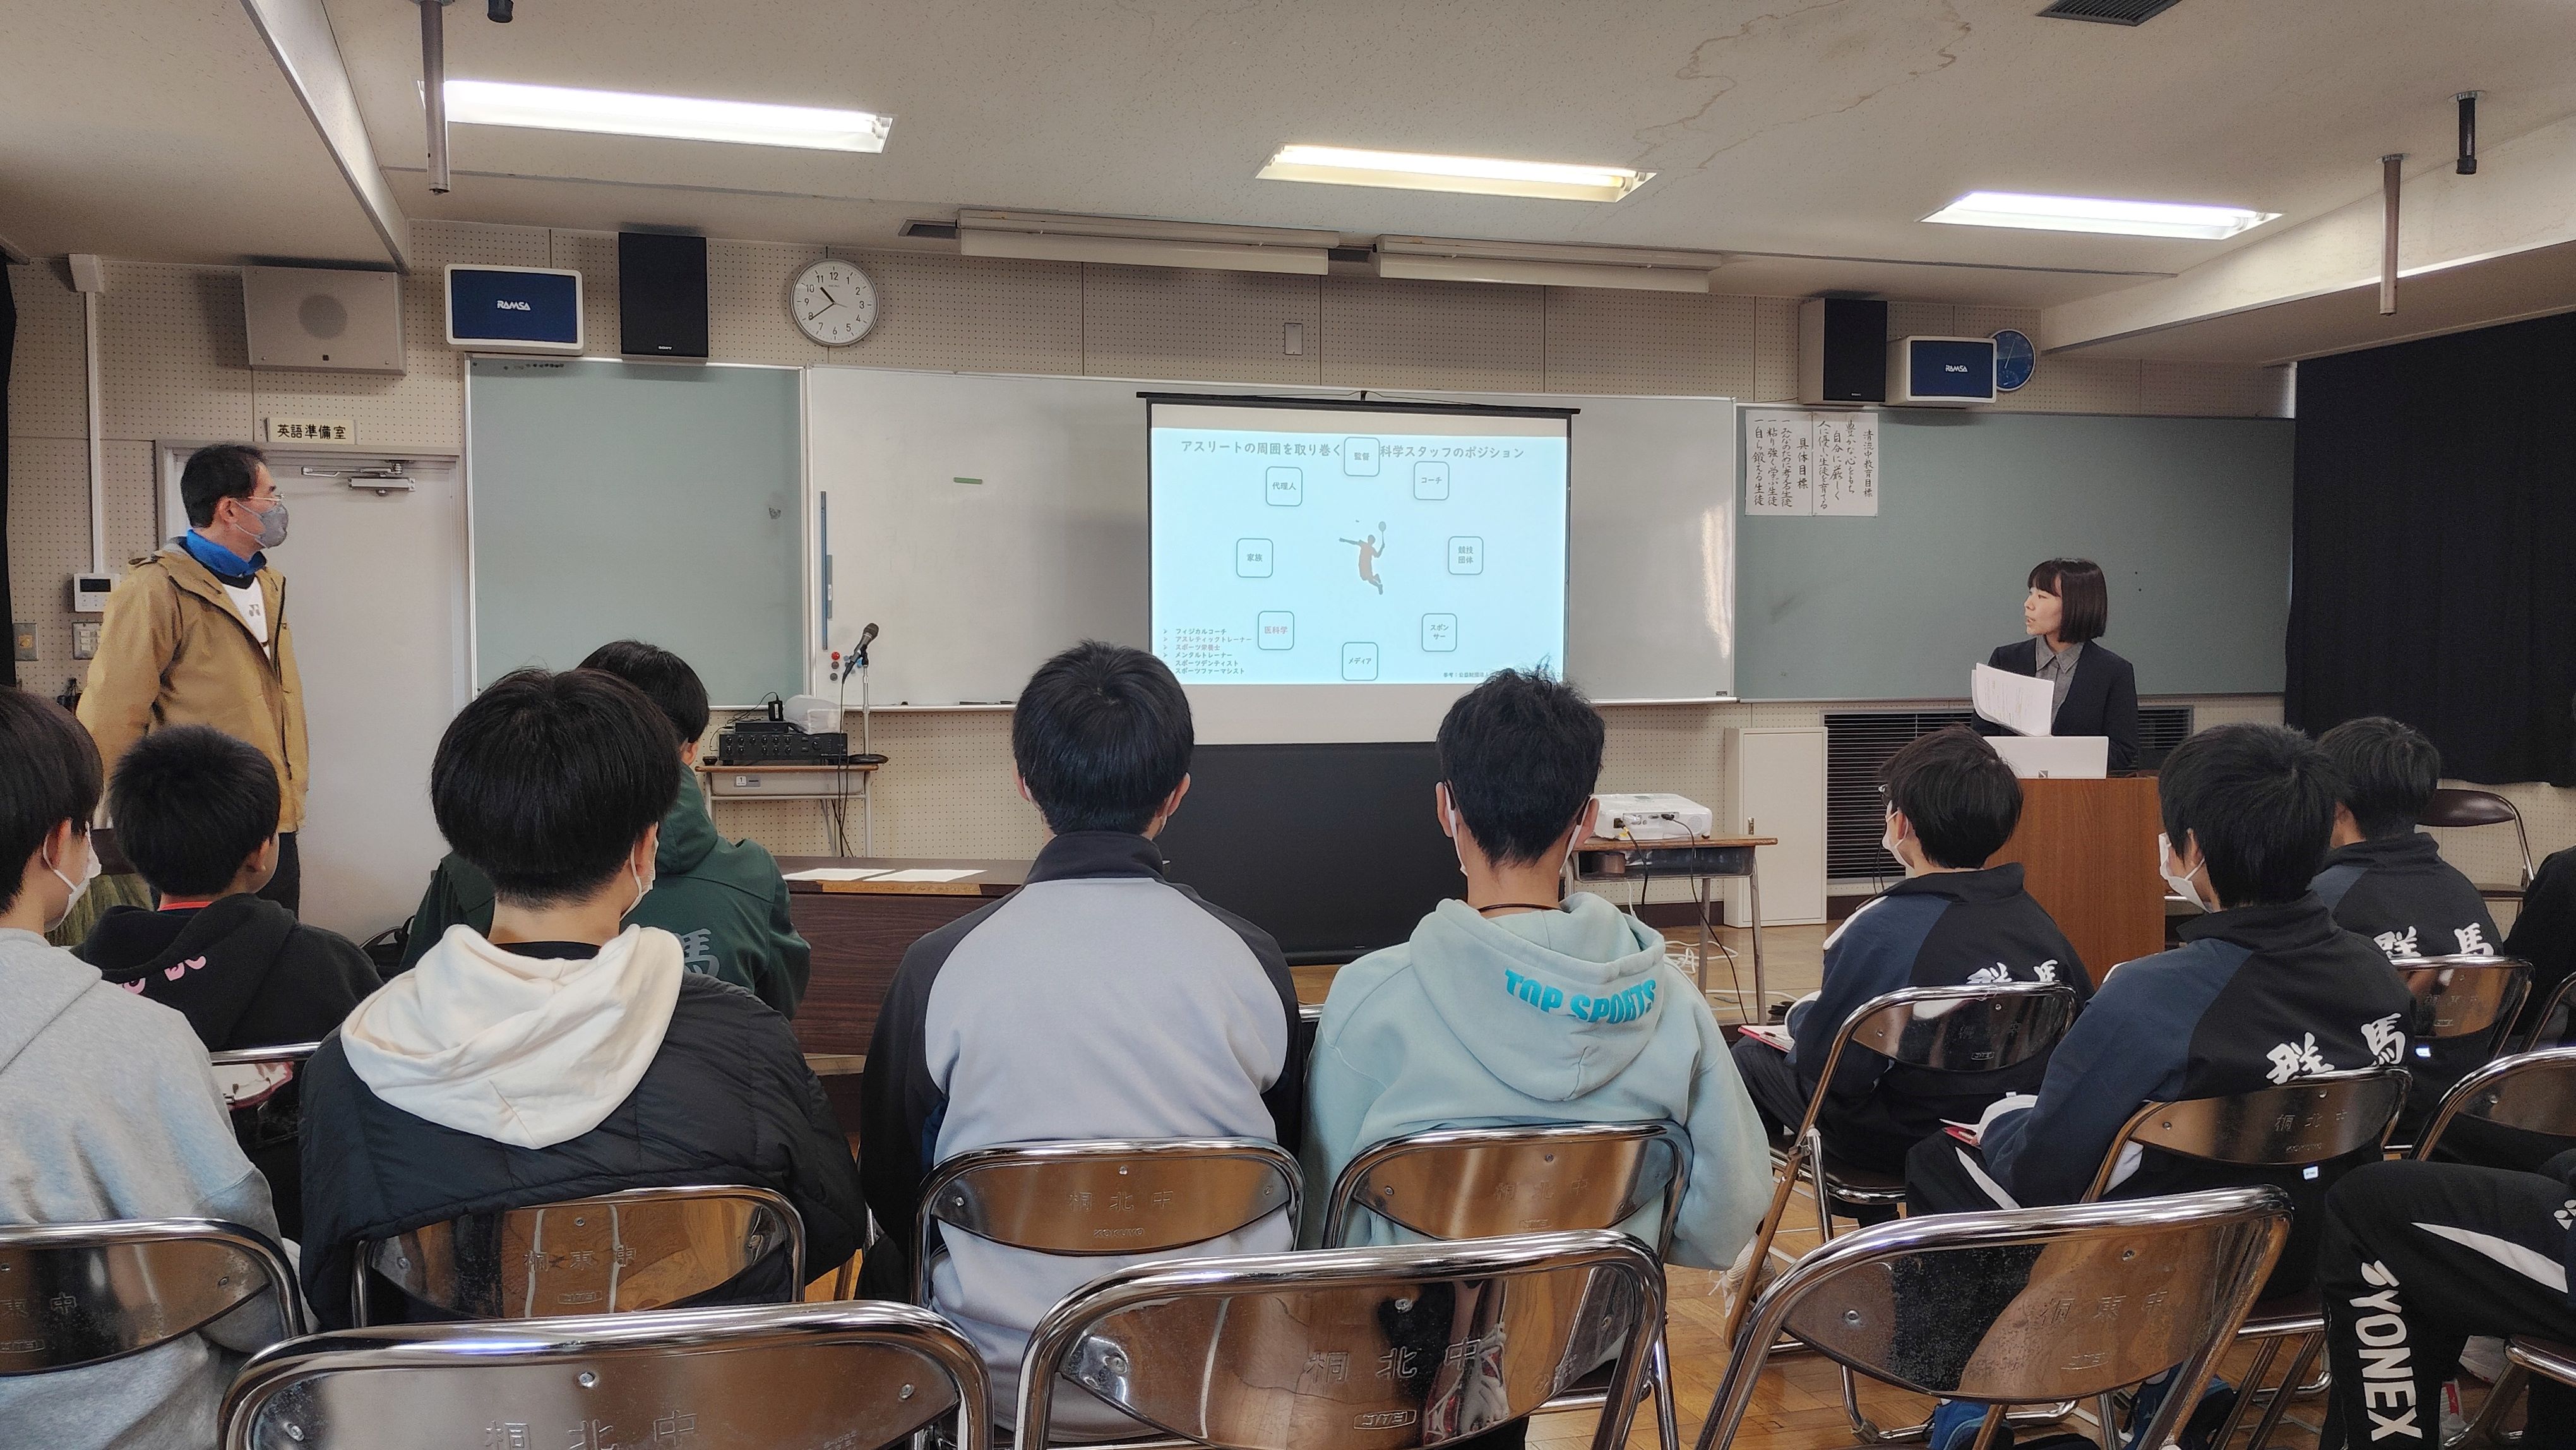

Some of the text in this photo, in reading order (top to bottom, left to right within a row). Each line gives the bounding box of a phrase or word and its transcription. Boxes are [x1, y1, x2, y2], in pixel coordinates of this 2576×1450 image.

[816, 275, 824, 283] 11
[830, 272, 838, 280] 12
[806, 284, 814, 292] 10
[855, 287, 861, 296] 2
[497, 300, 531, 311] RAMSA
[804, 298, 809, 306] 9
[859, 301, 864, 309] 3
[808, 312, 813, 320] 8
[819, 322, 823, 330] 7
[846, 323, 851, 332] 5
[832, 327, 837, 335] 6
[277, 424, 346, 440] 英語準備室
[1181, 441, 1340, 457] アスリートの周囲を取り巻く
[1354, 452, 1370, 461] 監督
[1797, 438, 1809, 489] 具体目標
[1830, 430, 1843, 500] 自分に厳しく
[1272, 482, 1296, 491] 代理人
[1246, 553, 1263, 562] 家族
[1458, 556, 1474, 564] 団体
[1264, 626, 1288, 635] 医科学
[1505, 969, 1656, 1024] TOP SPORTS
[1093, 1227, 1145, 1238] KOKUYO
[2349, 1289, 2423, 1442] YONEX
